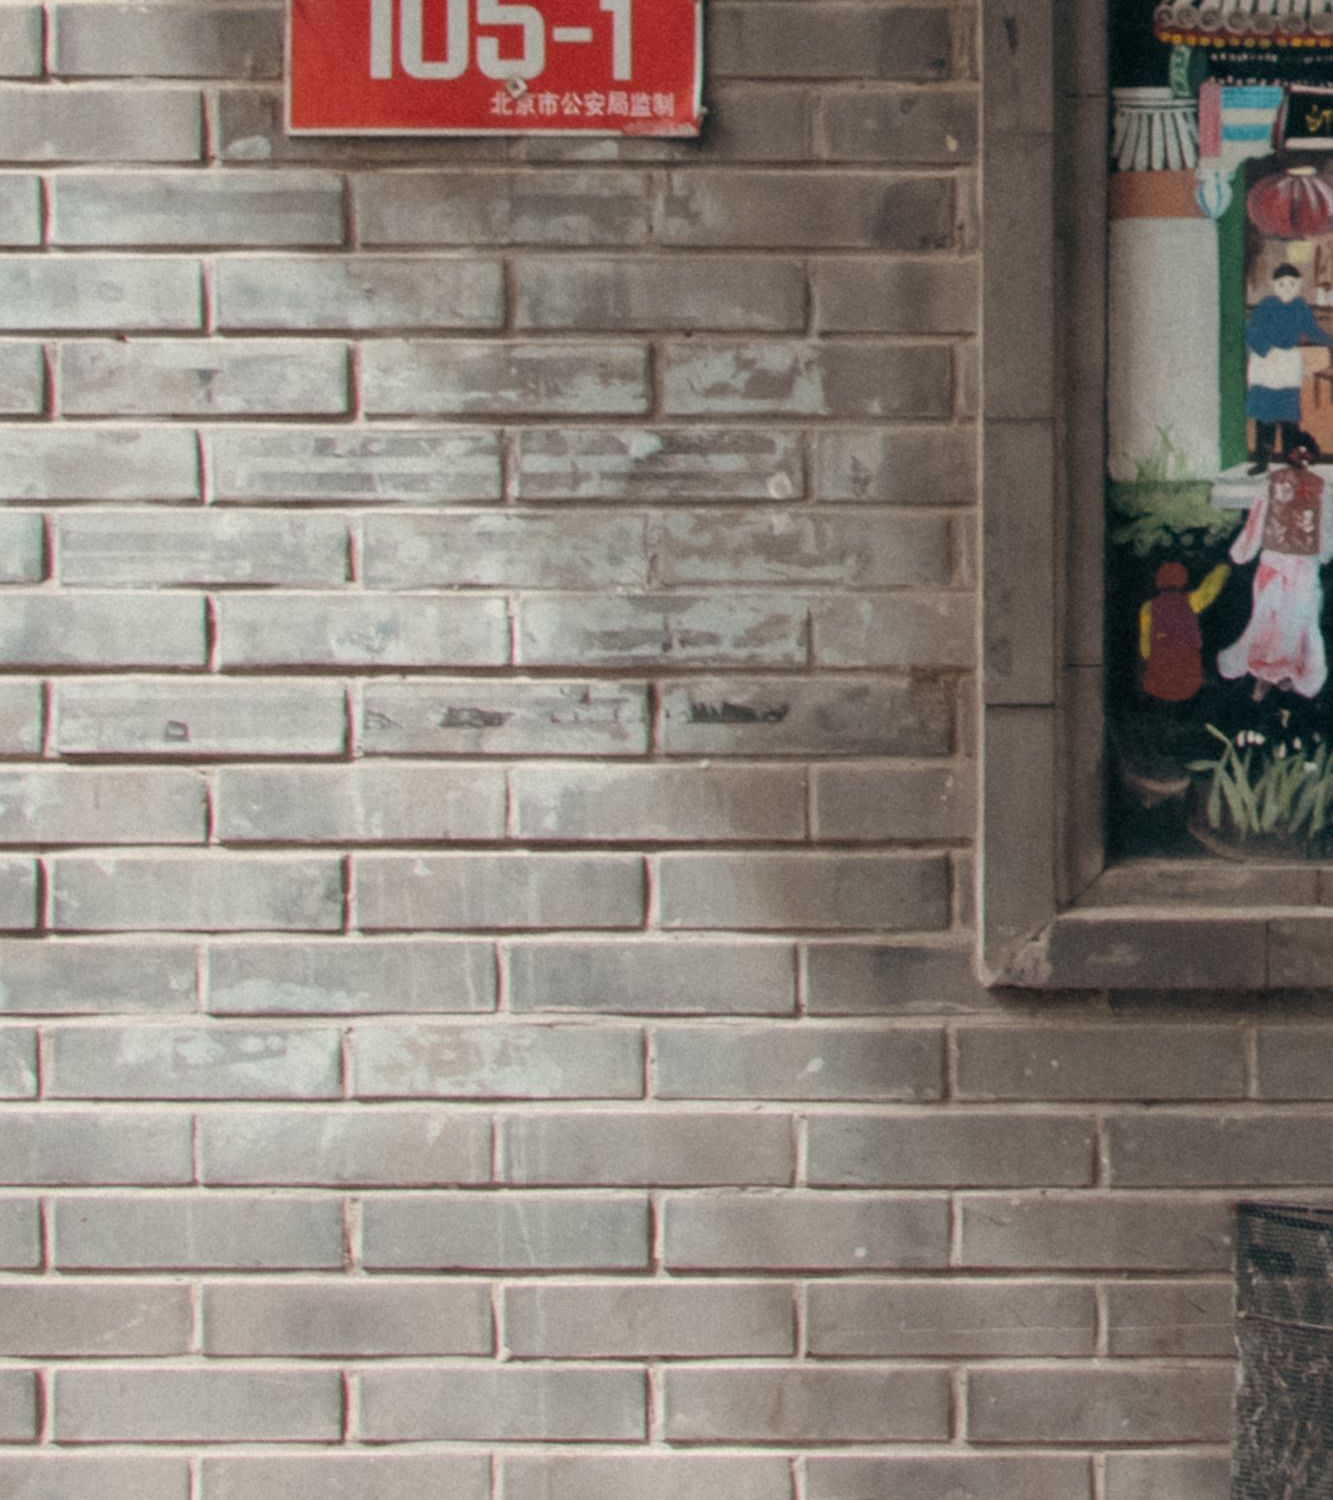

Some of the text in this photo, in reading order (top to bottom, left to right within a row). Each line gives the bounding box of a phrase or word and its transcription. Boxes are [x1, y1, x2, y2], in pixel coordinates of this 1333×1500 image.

[490, 90, 675, 118] 北京市公安局监制
